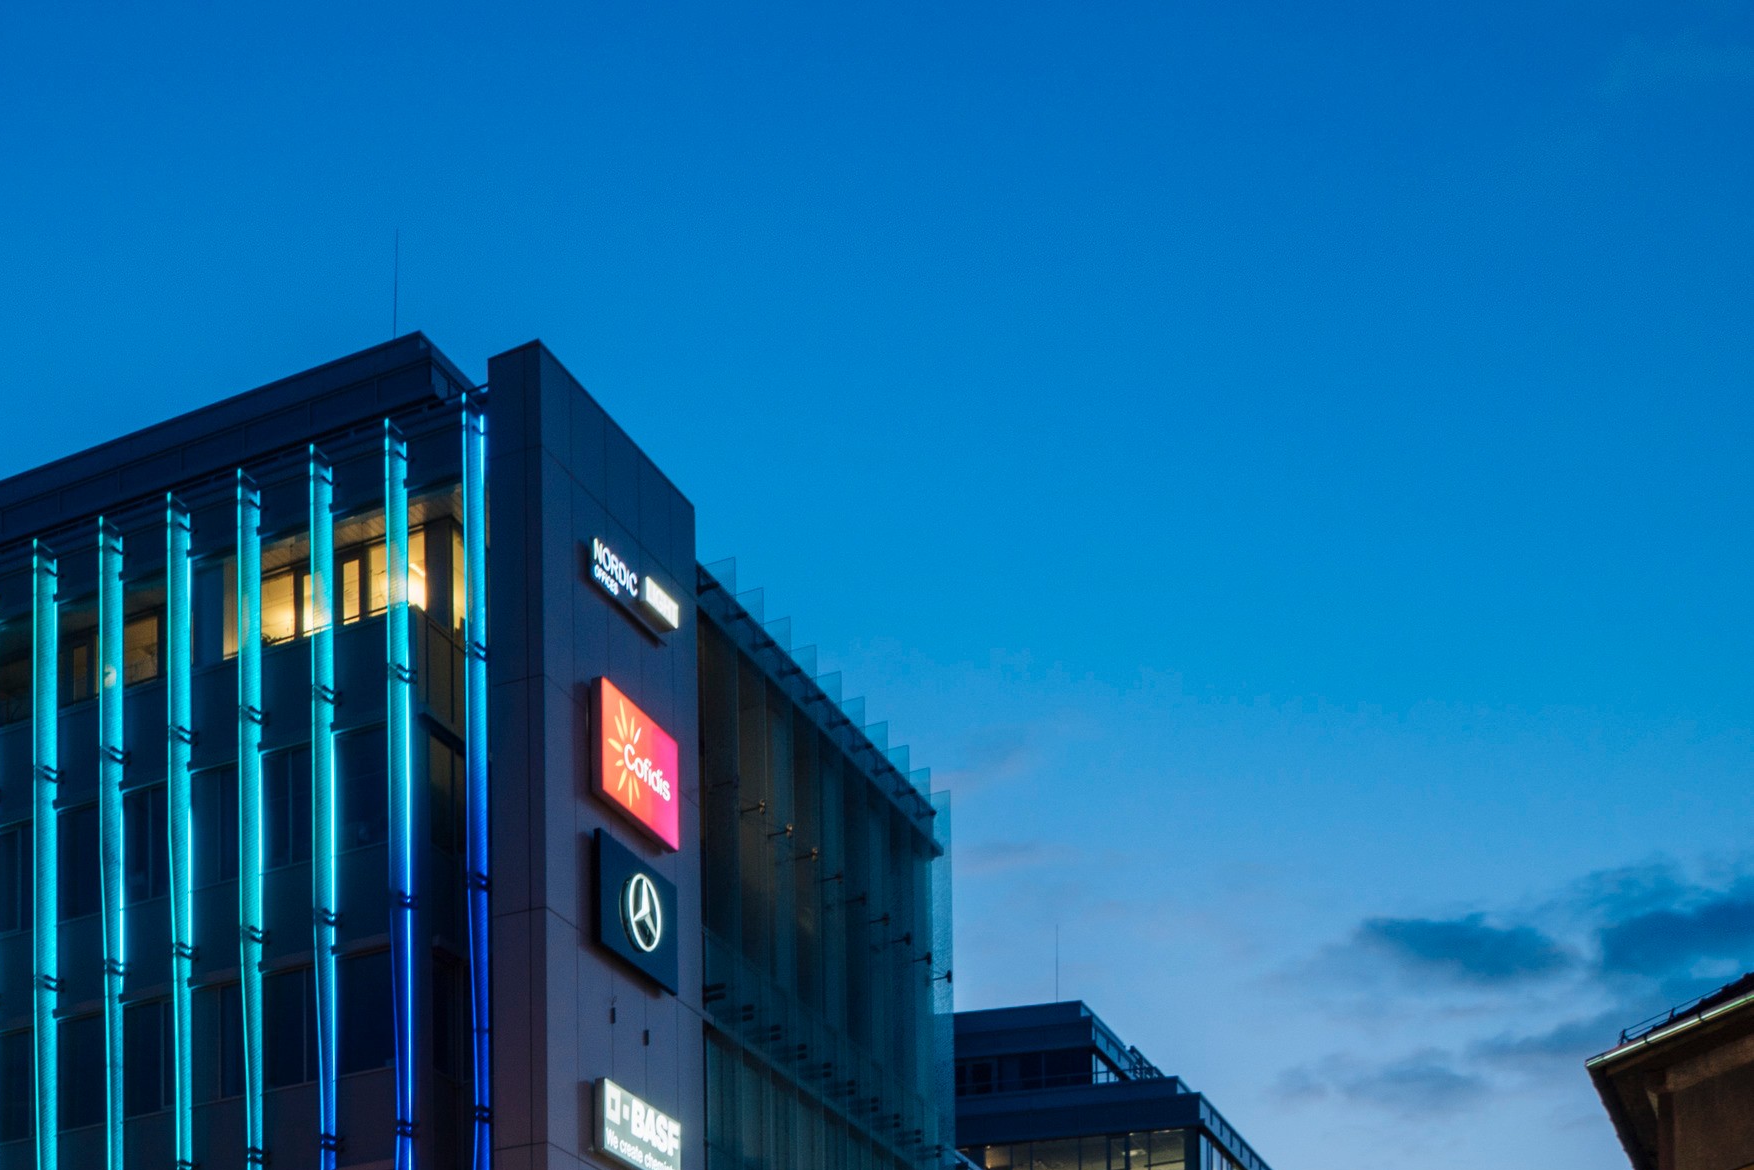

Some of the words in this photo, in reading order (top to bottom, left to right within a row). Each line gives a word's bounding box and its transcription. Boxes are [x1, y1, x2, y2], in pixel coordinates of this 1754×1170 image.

[593, 538, 638, 597] NORDIC
[624, 743, 671, 801] Cofidis
[605, 1127, 618, 1150] We
[619, 1139, 643, 1164] create
[631, 1098, 679, 1157] BASF
